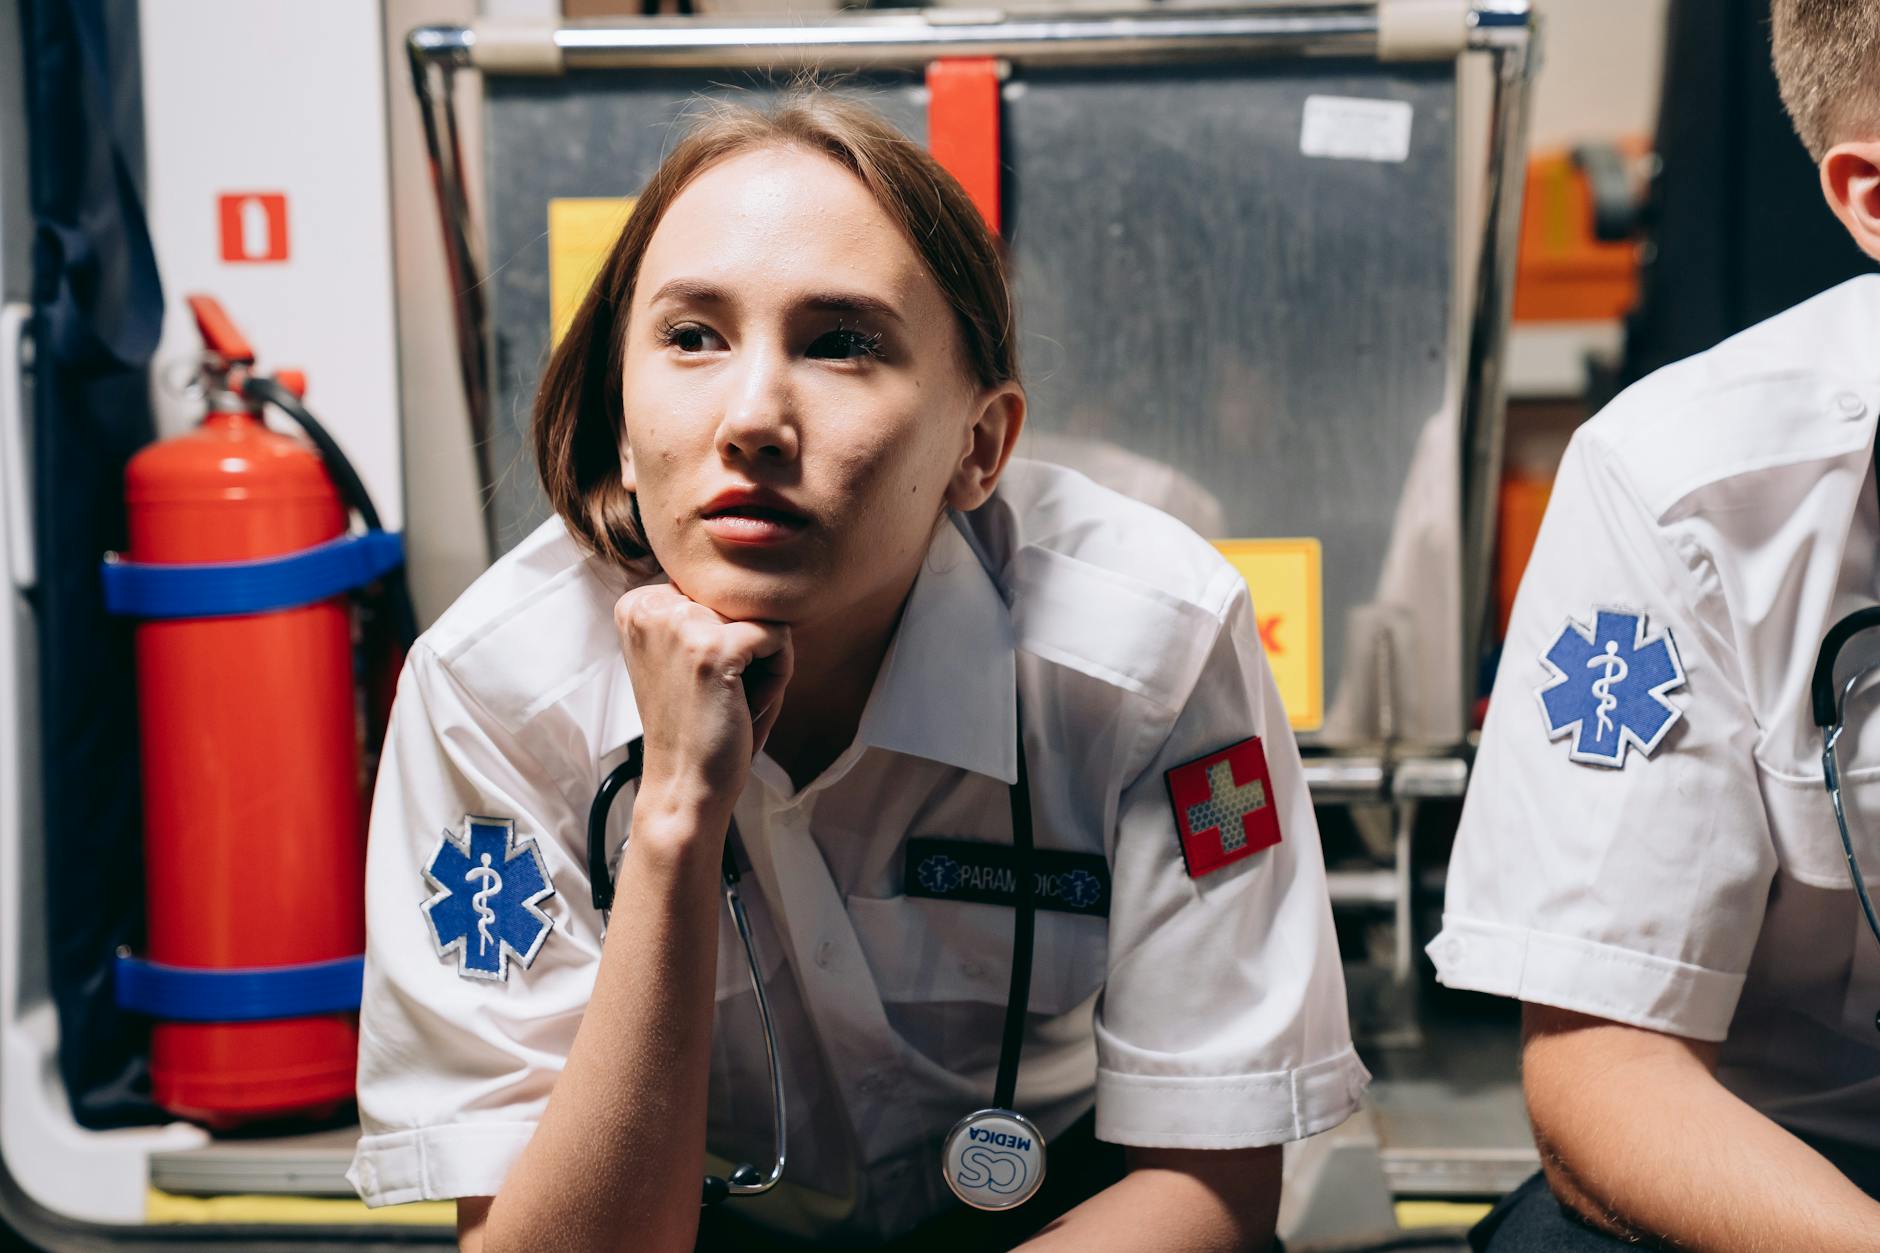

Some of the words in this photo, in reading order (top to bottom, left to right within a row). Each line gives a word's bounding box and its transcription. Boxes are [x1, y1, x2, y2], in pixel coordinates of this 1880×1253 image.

[960, 864, 1058, 897] PARAMDIC
[969, 1126, 1031, 1152] MEDICA
[957, 1145, 1027, 1195] CS
